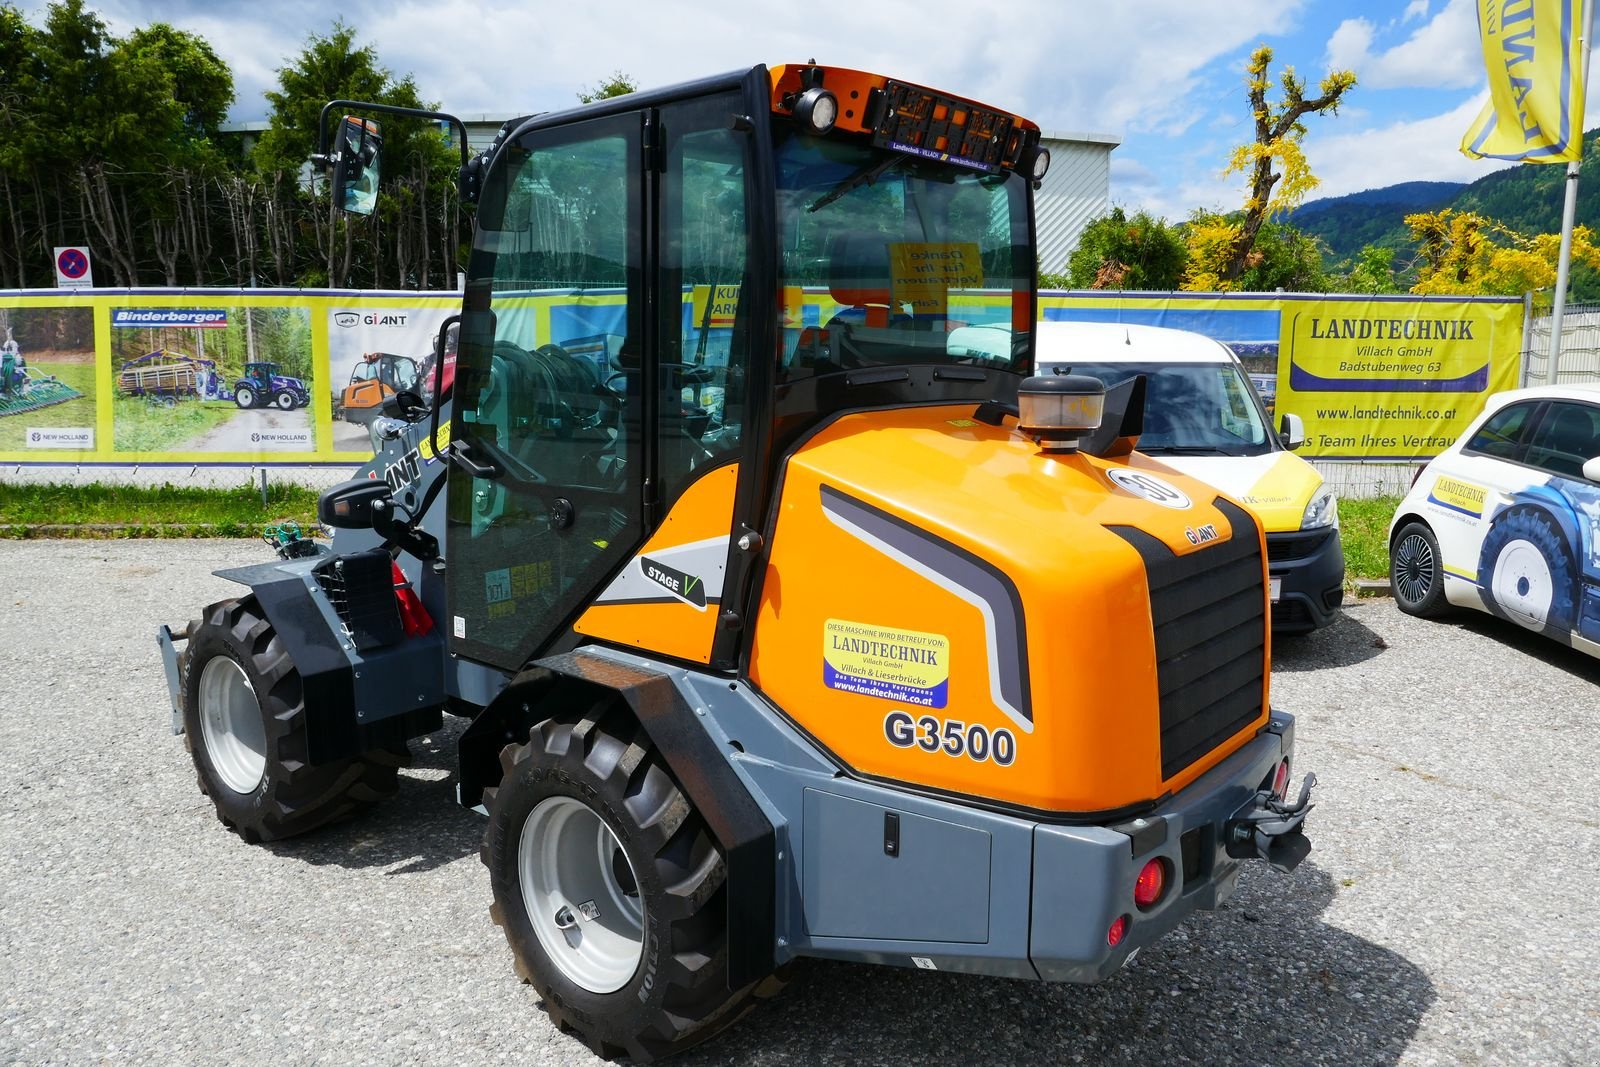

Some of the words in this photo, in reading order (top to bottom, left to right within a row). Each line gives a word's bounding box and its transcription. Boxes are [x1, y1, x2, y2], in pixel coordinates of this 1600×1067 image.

[893, 142, 919, 154] Landtechnik
[922, 150, 939, 159] VILLACH
[116, 311, 224, 323] Binderberger
[1311, 318, 1474, 340] LANDTECHNIK
[1356, 346, 1393, 356] Villach
[1397, 347, 1433, 357] GmbH
[1339, 361, 1423, 374] Badstubenweg
[1427, 362, 1441, 372] 63
[1316, 405, 1456, 420] www.landtechnik.co.at
[1299, 437, 1313, 447] as
[1318, 434, 1356, 447] Team
[1361, 434, 1396, 447] Ihres
[1403, 434, 1456, 448] Vertrau
[1118, 474, 1179, 502] 30
[1437, 479, 1487, 503] LANDTECHNIK
[1449, 497, 1466, 506] Villach
[648, 566, 680, 591] STAGE
[684, 576, 700, 596] V
[827, 623, 844, 632] DIESE
[845, 626, 877, 637] MASCHINE
[879, 631, 896, 640] WIRD
[897, 634, 927, 644] BETREUT
[927, 639, 945, 648] VON:
[833, 635, 937, 665] LANDTECHNIK
[863, 657, 883, 666] Villach
[883, 661, 903, 670] GmbH
[835, 673, 847, 681] Das
[850, 676, 867, 684] Team
[870, 680, 888, 688] Ihres
[892, 683, 933, 696] Vertrauens
[841, 664, 866, 676] Villach
[868, 669, 875, 677] &
[875, 670, 927, 686] Lieserbrücke
[834, 681, 933, 706] www.landtechnik.co.at
[883, 710, 1016, 767] G3500
